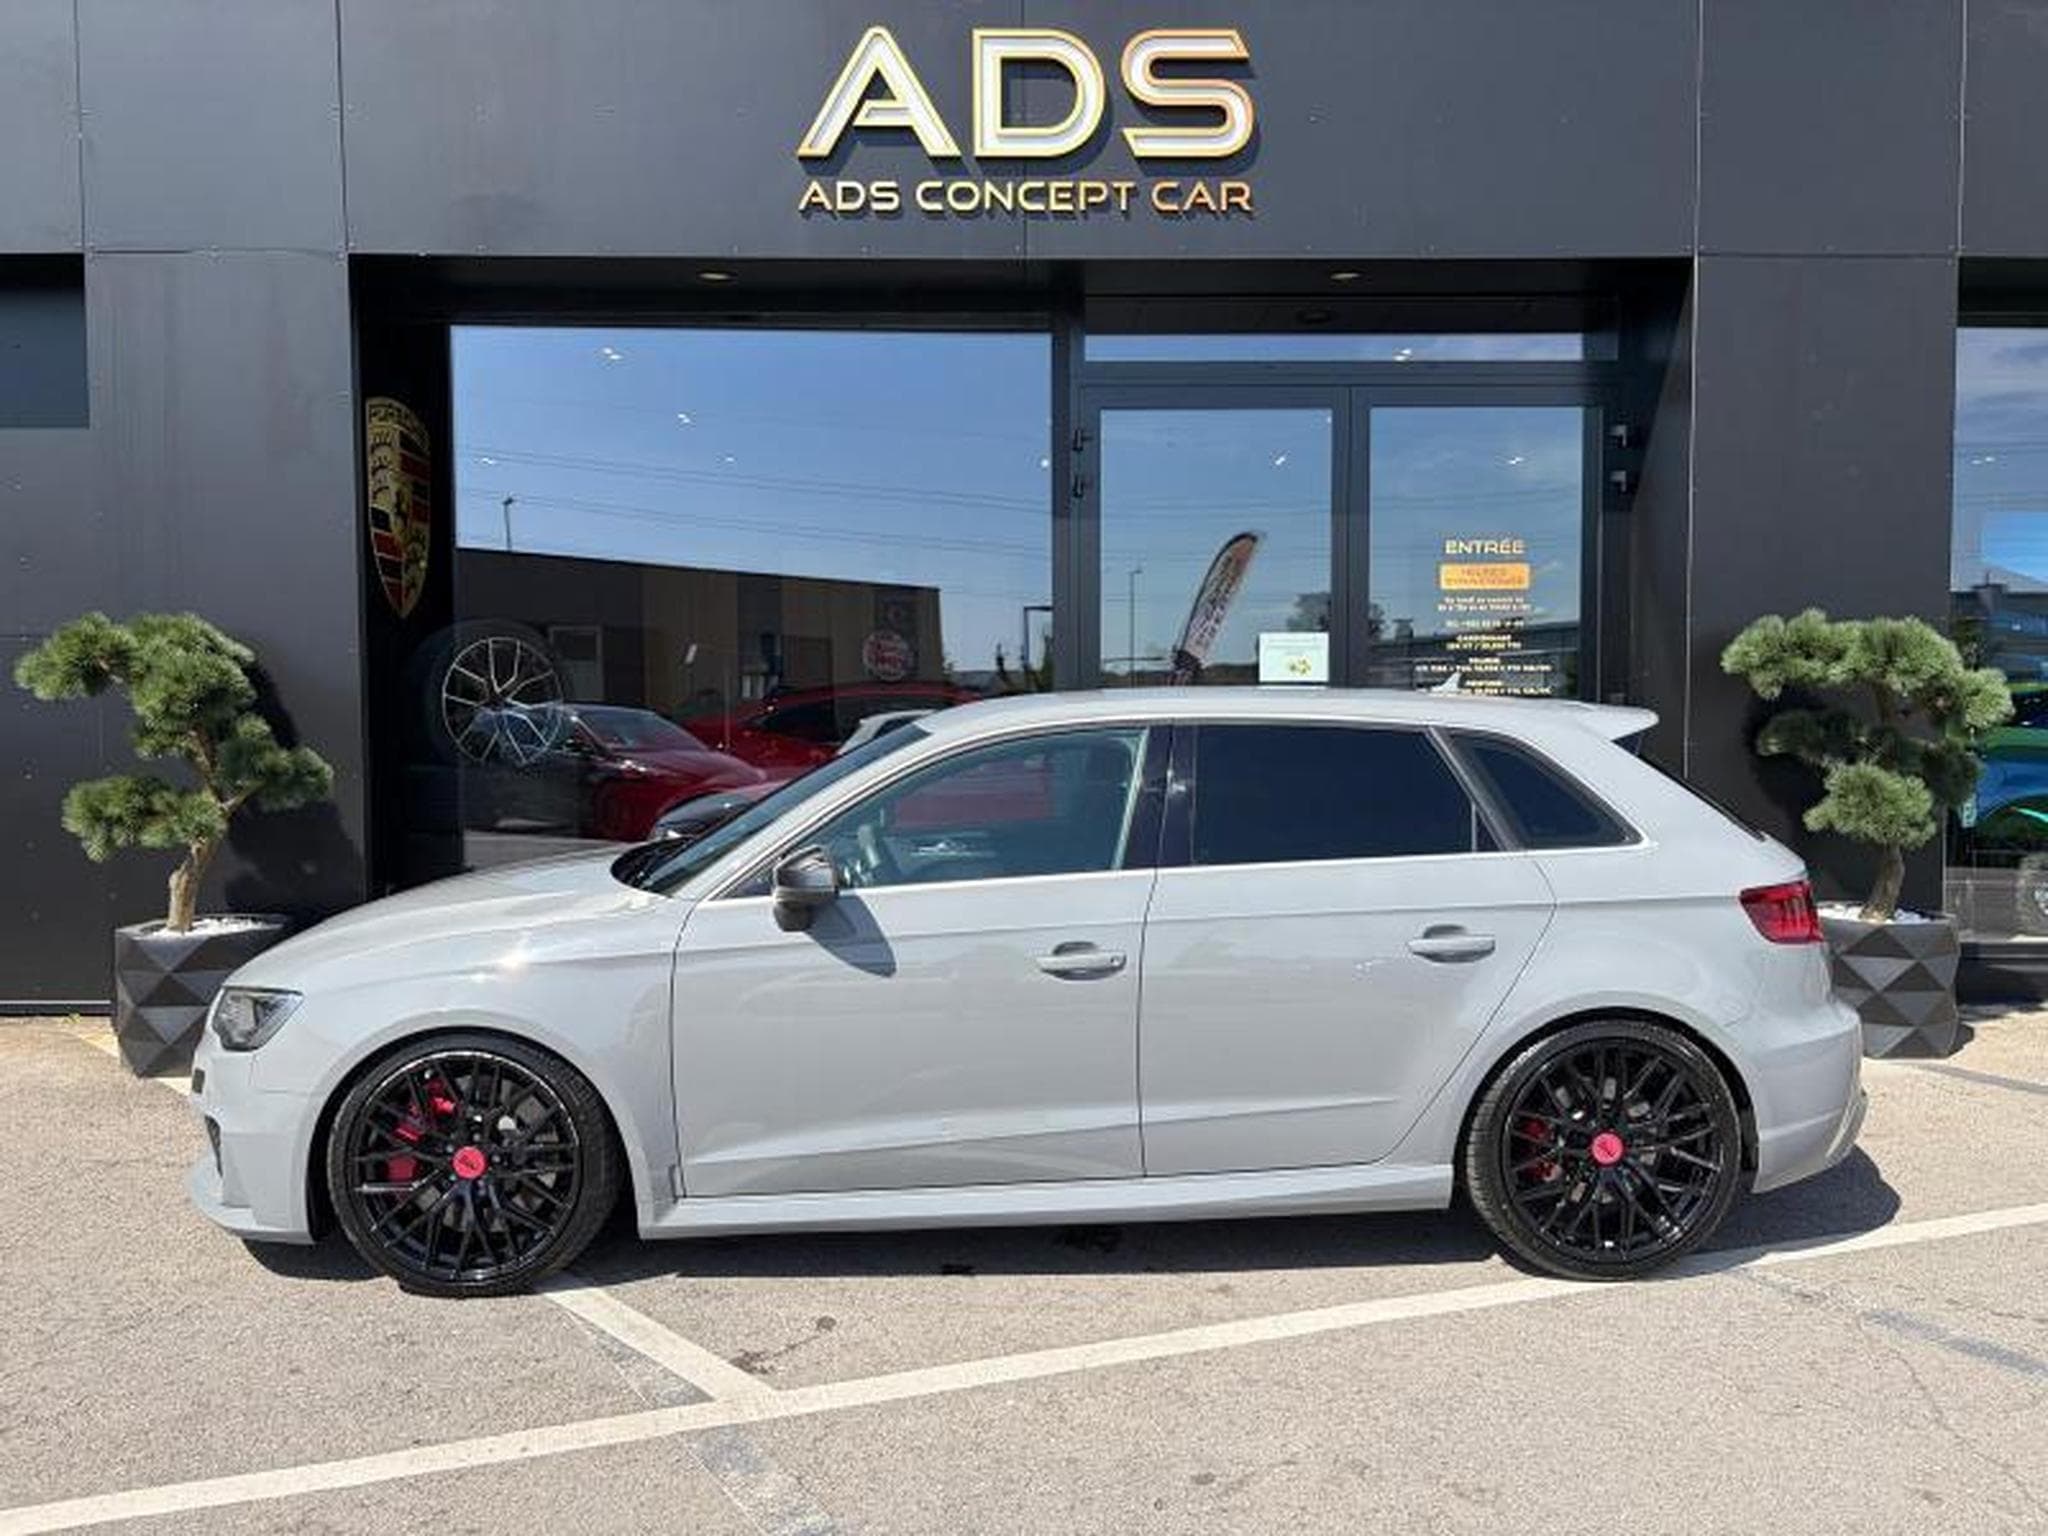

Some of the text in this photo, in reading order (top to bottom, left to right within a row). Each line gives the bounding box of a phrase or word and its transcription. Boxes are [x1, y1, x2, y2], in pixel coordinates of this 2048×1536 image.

[797, 25, 1254, 158] ADS
[798, 181, 1253, 212] ADS CONCEPT CAR
[1445, 537, 1525, 554] ENTRÉE
